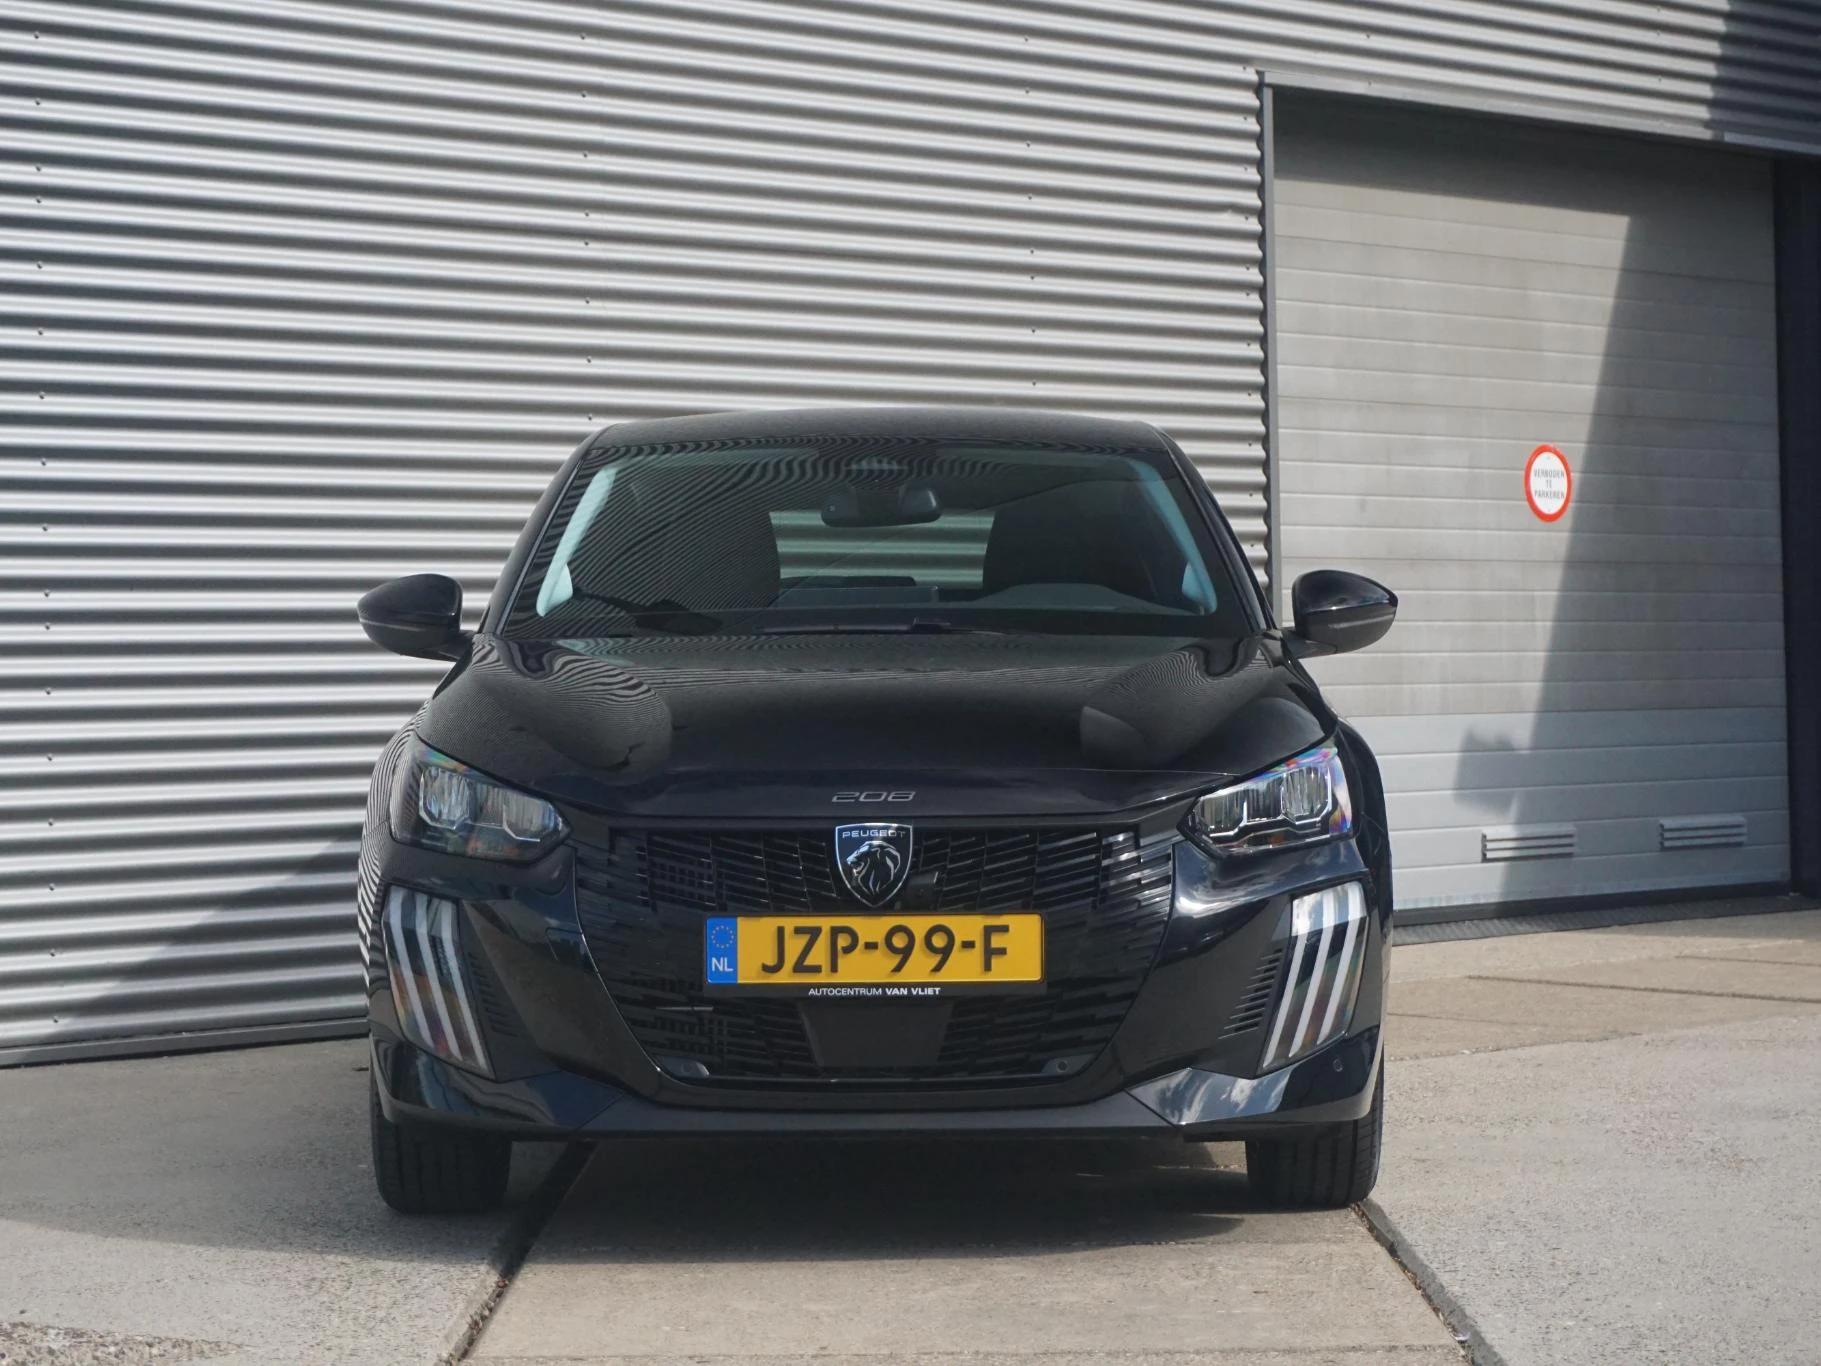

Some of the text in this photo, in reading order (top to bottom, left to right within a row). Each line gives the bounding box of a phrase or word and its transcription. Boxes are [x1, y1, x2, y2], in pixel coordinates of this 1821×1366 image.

[831, 791, 916, 802] 208
[842, 829, 905, 838] PEUGEOT
[761, 924, 1009, 974] JZP-99-F
[711, 957, 734, 972] NL
[808, 987, 940, 996] AUTOCENTRUM VAN VLIET
